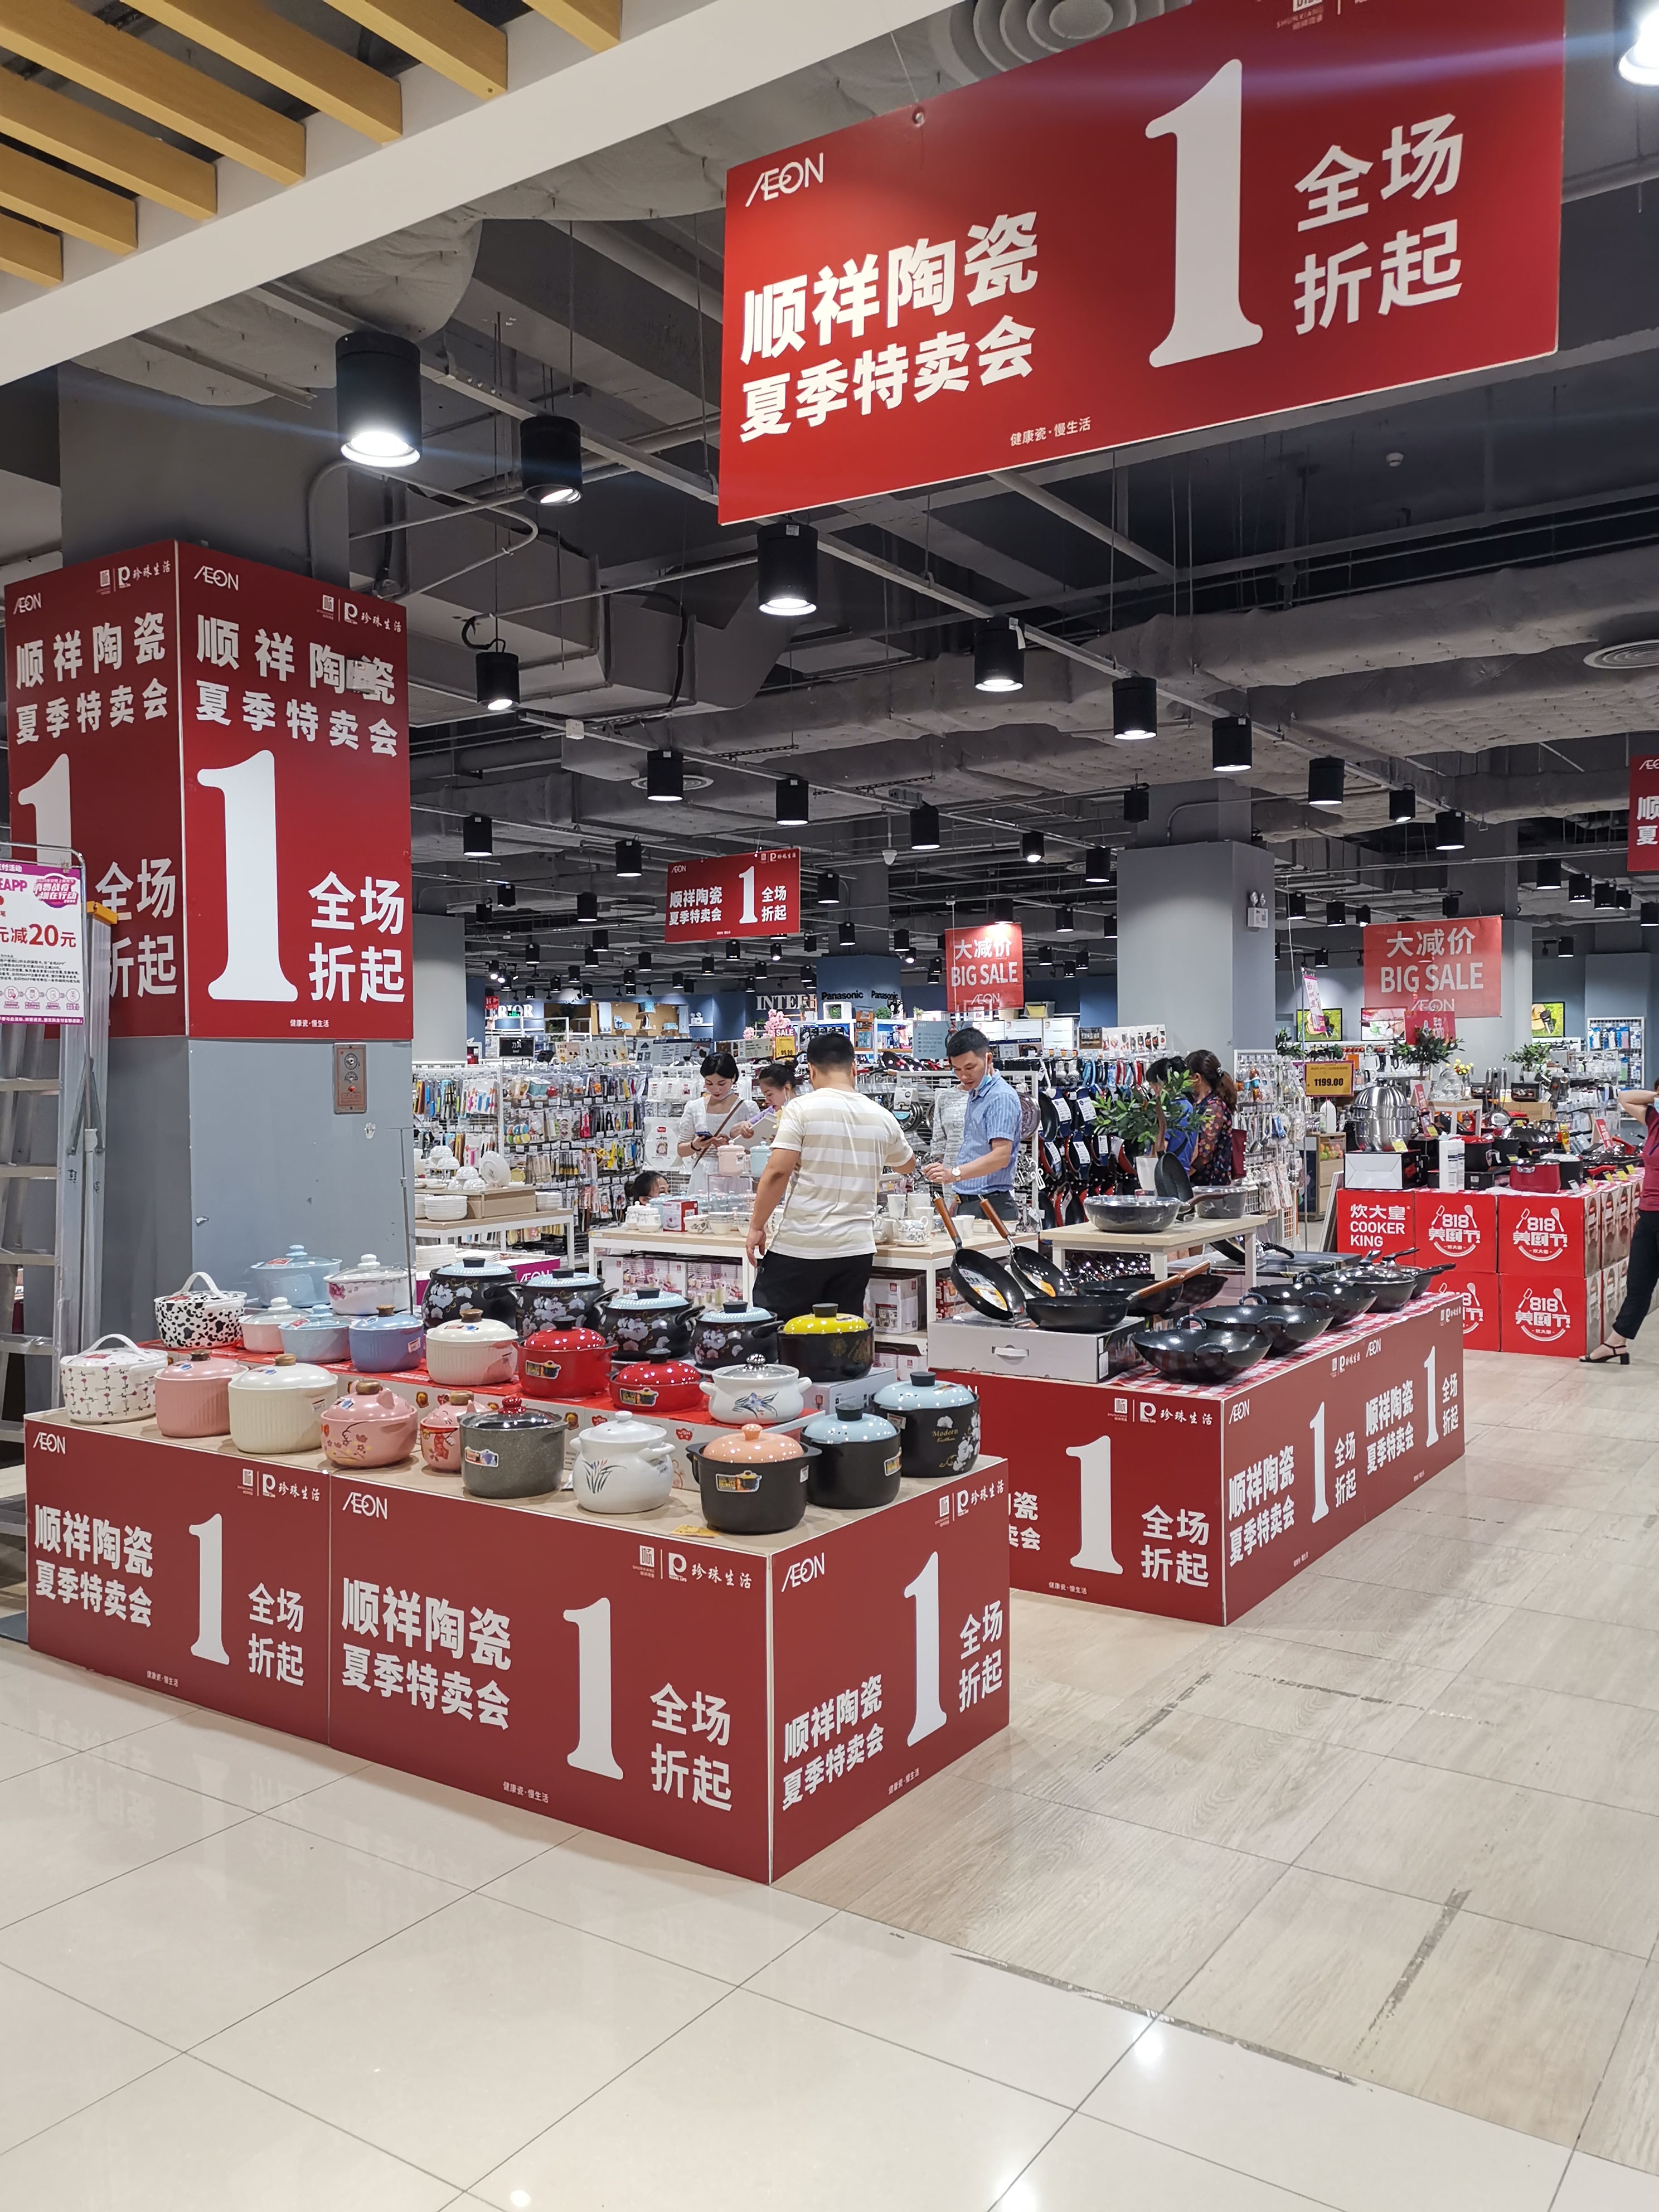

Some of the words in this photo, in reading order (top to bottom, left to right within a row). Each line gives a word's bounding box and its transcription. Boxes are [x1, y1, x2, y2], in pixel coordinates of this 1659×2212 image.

[1296, 114, 1463, 231] 全场
[1146, 59, 1263, 367] 1
[741, 211, 1039, 364] 顺祥陶瓷
[1294, 220, 1462, 334] 折起
[740, 316, 1036, 443] 夏季特卖会
[16, 612, 164, 690] 顺祥陶瓷
[196, 614, 395, 706] 顺祥陶瓷
[16, 678, 168, 745] 夏季特卖会
[196, 680, 399, 758] 夏季特卖会
[96, 858, 174, 921] 全场
[197, 750, 298, 1002] 1
[309, 871, 405, 935] 全场
[670, 886, 722, 908] 顺祥陶瓷
[739, 866, 758, 924] 1
[761, 885, 786, 903] 全场
[669, 907, 722, 926] 夏季特卖会
[761, 905, 787, 922] 折起
[1386, 926, 1475, 958] 大减价
[310, 943, 405, 1003] 折起
[951, 964, 977, 987] BIG
[979, 961, 1018, 984] SALE
[954, 937, 1012, 960] 大减价
[1381, 965, 1419, 993] BIG
[1425, 962, 1483, 991] SALE
[821, 990, 864, 1000] Panasonic
[871, 991, 899, 1000] Panasonic
[1314, 1078, 1343, 1086] 1199.00
[1350, 1204, 1405, 1220] 炊大皇
[1350, 1221, 1405, 1234] COOKER
[1350, 1234, 1383, 1247] KING
[1442, 1214, 1469, 1228] 818
[1527, 1217, 1556, 1232] 818
[1530, 1297, 1559, 1312] 818
[1160, 1408, 1213, 1425] 珍珠生活
[1366, 1380, 1413, 1437] 顺祥陶瓷
[1424, 1345, 1439, 1448] 1
[1442, 1372, 1458, 1404] 全场
[1366, 1422, 1414, 1476] 夏季特卖会
[1442, 1404, 1459, 1437] 折起
[1309, 1401, 1329, 1524] 1
[1335, 1431, 1355, 1469] 全场
[279, 1481, 320, 1501] 珍珠生活
[1008, 1491, 1039, 1521] 瓷
[1065, 1435, 1123, 1575] 1
[1228, 1445, 1294, 1521] 顺祥陶瓷
[1335, 1468, 1356, 1508] 折起
[35, 1504, 153, 1578] 顺祥陶瓷
[1142, 1505, 1209, 1546] 全场
[1229, 1495, 1294, 1567] 夏季特卖会
[36, 1560, 152, 1627] 夏季特卖会
[188, 1513, 230, 1665] 1
[692, 1563, 752, 1589] 珍珠生活
[1141, 1545, 1209, 1588] 折起
[248, 1582, 304, 1632] 全场
[341, 1577, 512, 1671] 顺祥陶瓷
[960, 1600, 1003, 1660] 全场
[248, 1633, 304, 1686] 折起
[904, 1551, 947, 1747] 1
[341, 1643, 510, 1730] 夏季特卖会
[563, 1597, 623, 1781] 1
[959, 1648, 1003, 1713] 折起
[650, 1683, 730, 1747] 全场
[784, 1674, 883, 1764] 顺祥陶瓷
[651, 1743, 732, 1812] 折起
[783, 1723, 884, 1811] 夏季特卖会
